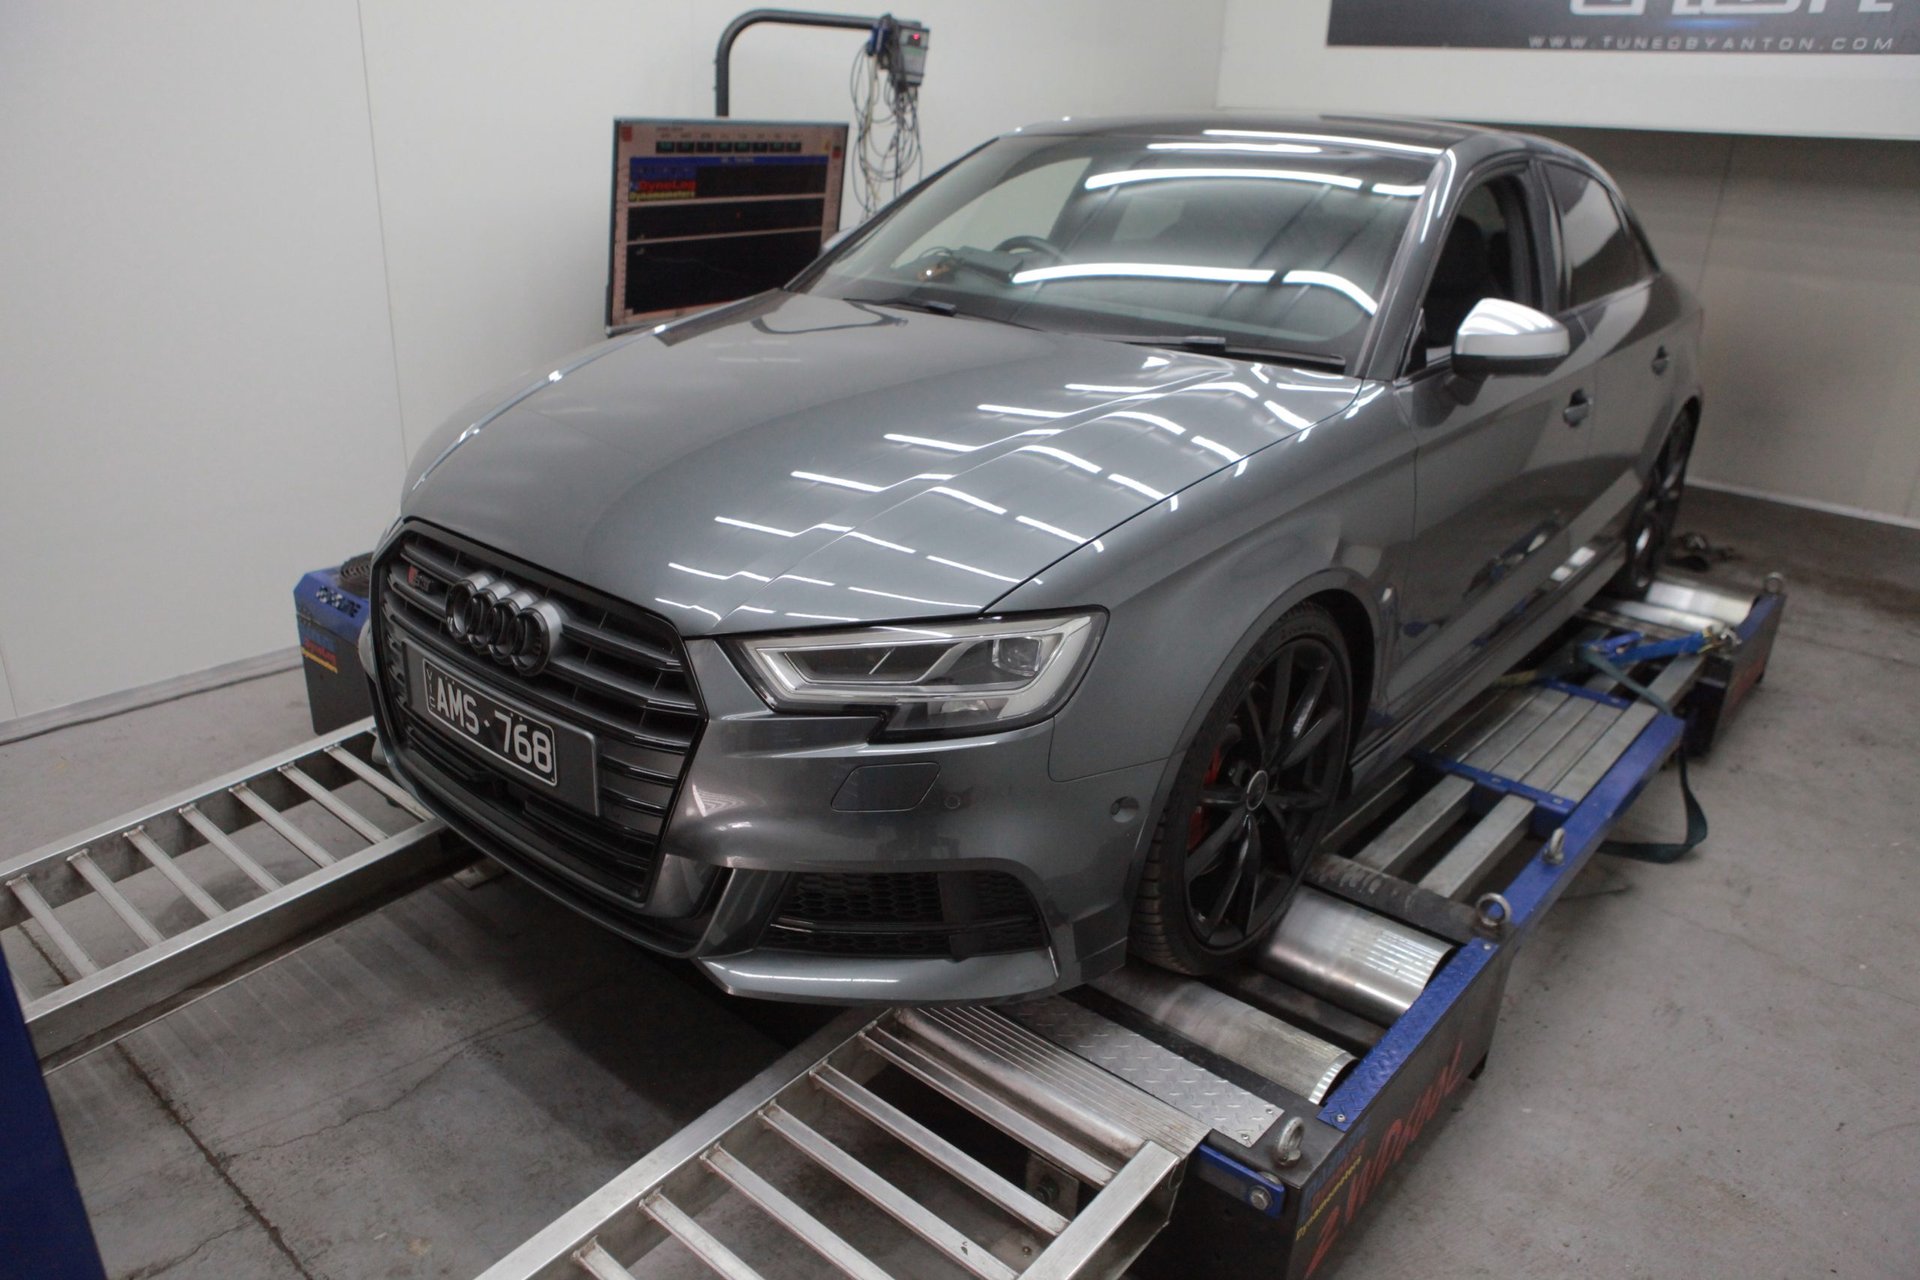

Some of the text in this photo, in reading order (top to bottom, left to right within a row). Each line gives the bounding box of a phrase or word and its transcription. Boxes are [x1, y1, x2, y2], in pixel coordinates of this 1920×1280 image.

[1528, 34, 1894, 51] WWW.TUNEDBYANTON.COM
[436, 677, 553, 774] AMS 768
